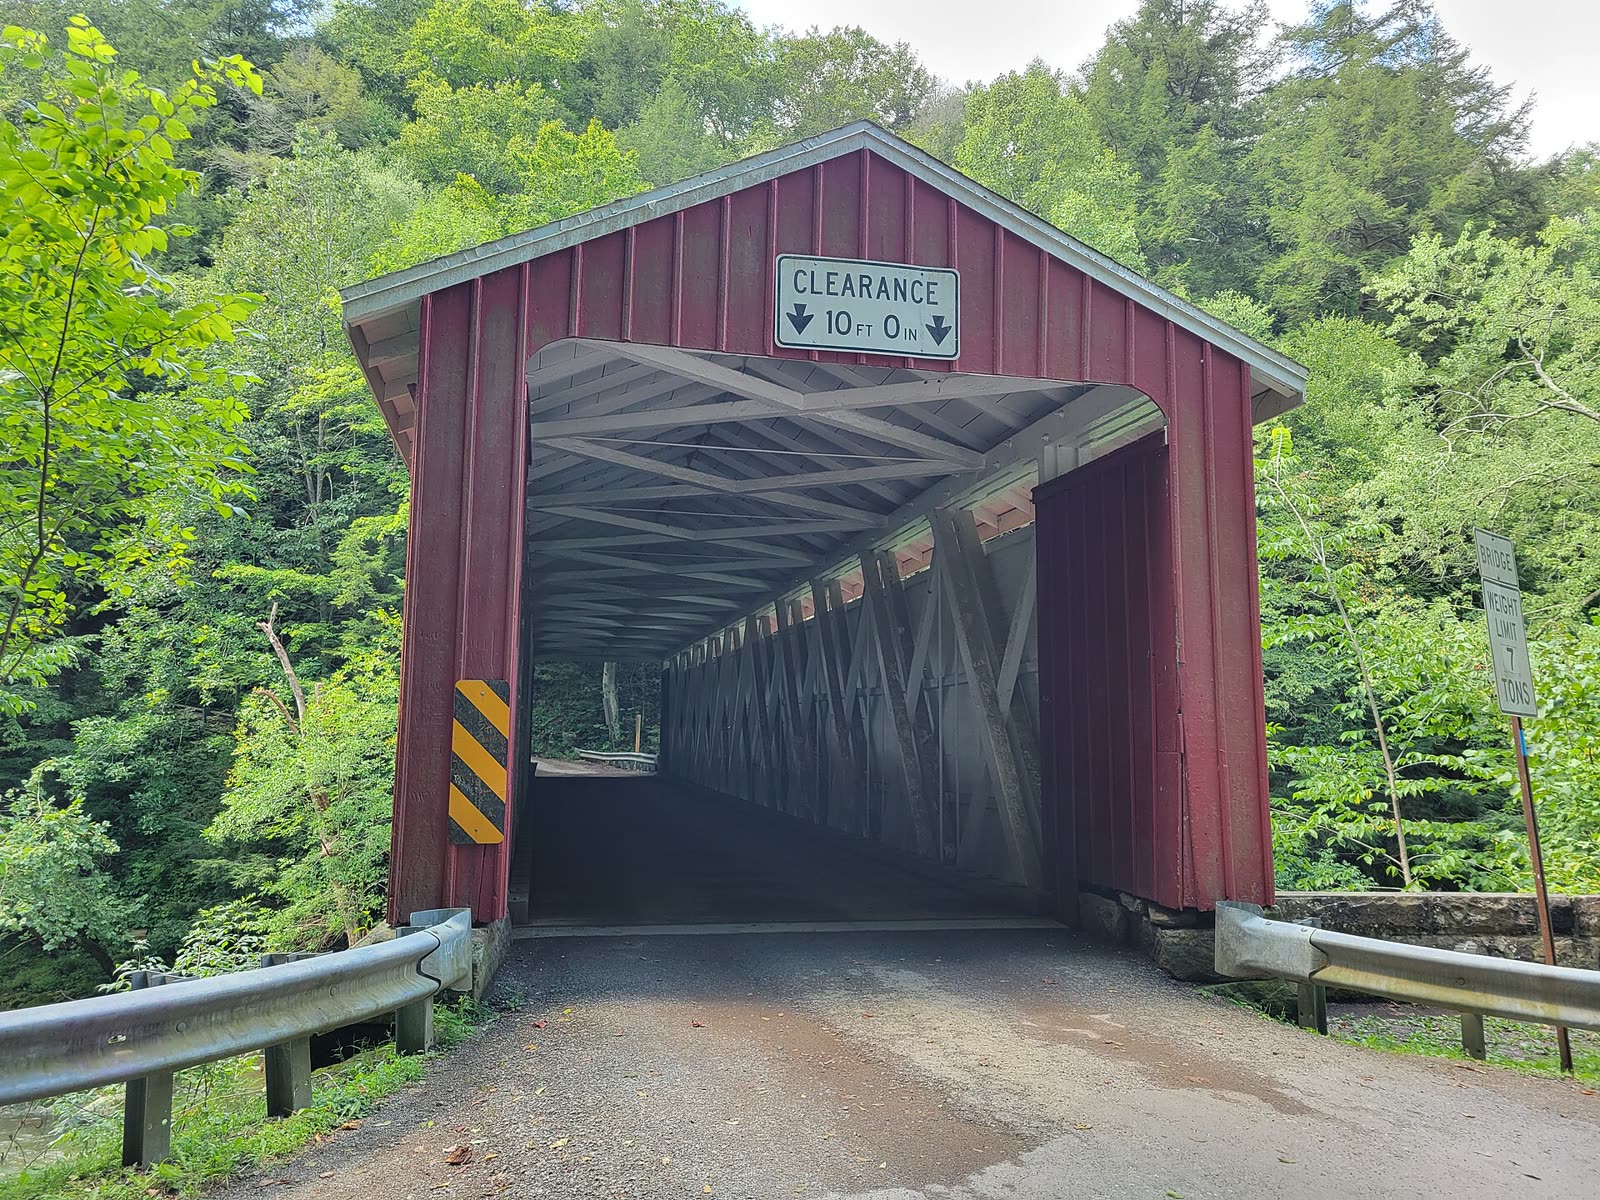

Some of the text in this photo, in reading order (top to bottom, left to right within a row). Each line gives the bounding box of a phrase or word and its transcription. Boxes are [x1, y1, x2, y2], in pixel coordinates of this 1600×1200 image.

[793, 269, 939, 306] CLEARANCE
[826, 310, 917, 341] 10 FT 0 IN
[1480, 544, 1512, 572] BRIDGE
[1487, 590, 1518, 617] WEIGHT
[1494, 617, 1517, 641] LIMIT
[1506, 647, 1514, 671] 7
[1502, 677, 1530, 706] TONS
